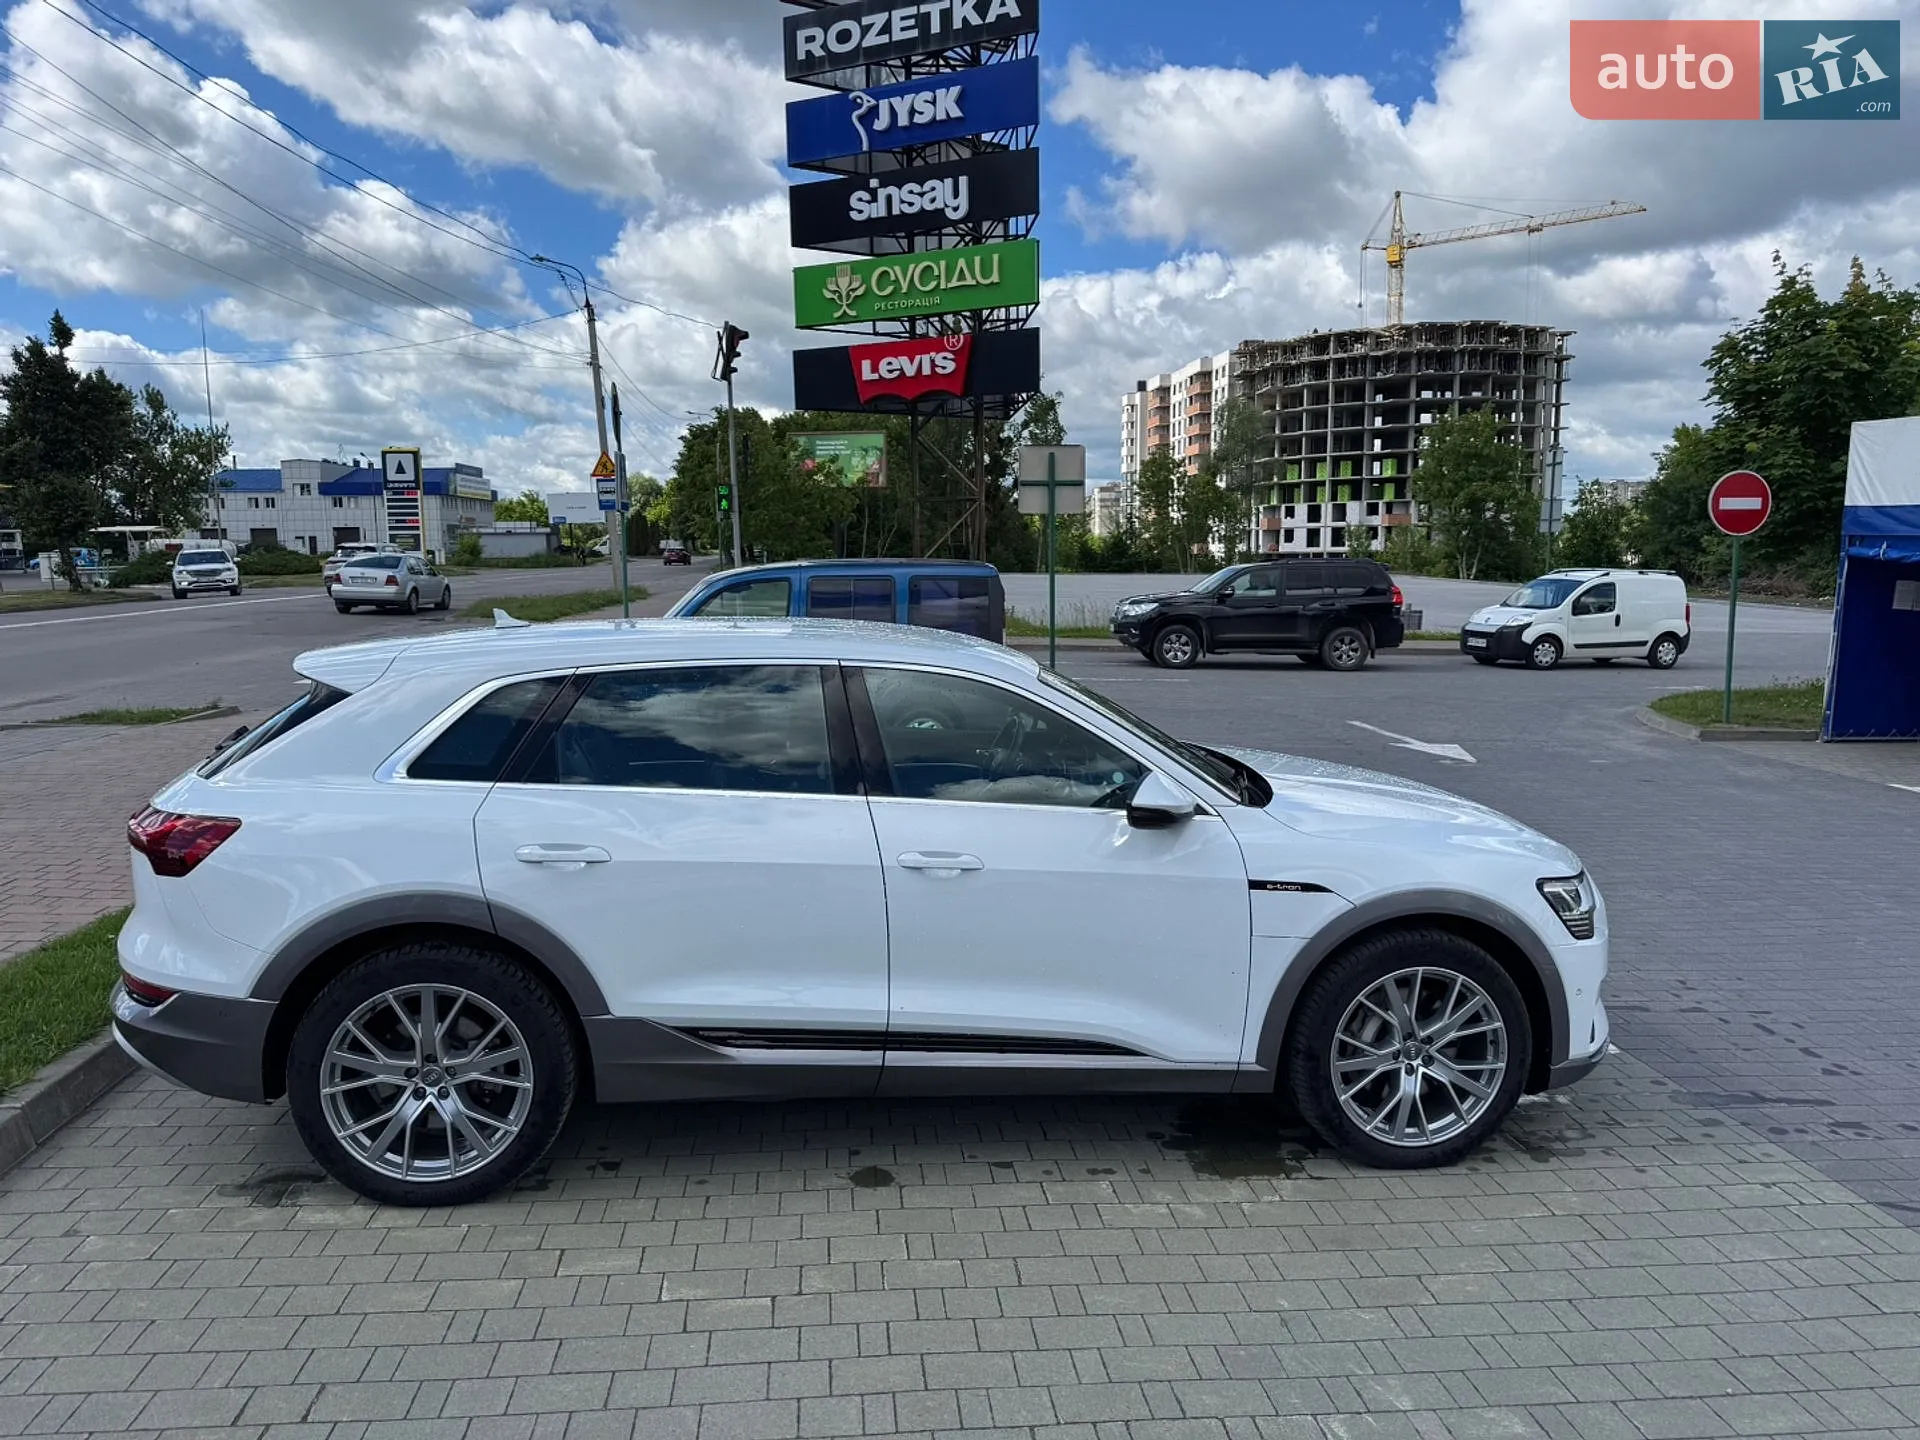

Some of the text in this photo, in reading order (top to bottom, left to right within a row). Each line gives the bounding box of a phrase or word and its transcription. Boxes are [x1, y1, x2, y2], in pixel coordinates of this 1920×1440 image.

[796, 0, 1022, 61] ROZETKA
[873, 85, 964, 132] JYSK
[849, 175, 969, 222] sinsay
[874, 296, 941, 311] РЕСТОРАЦІЯ
